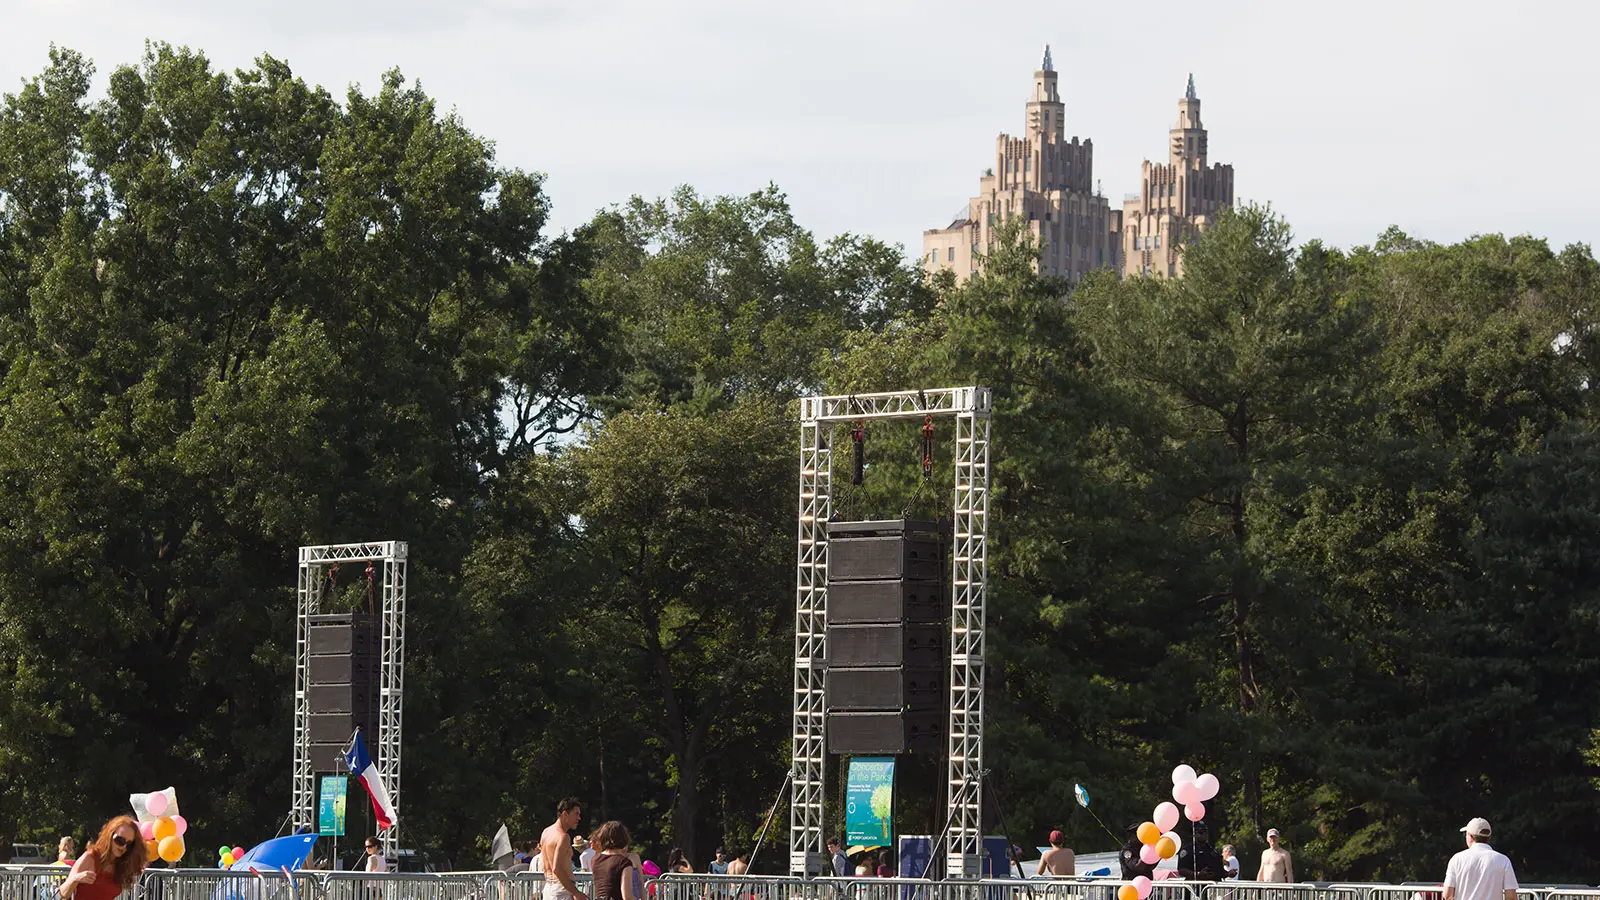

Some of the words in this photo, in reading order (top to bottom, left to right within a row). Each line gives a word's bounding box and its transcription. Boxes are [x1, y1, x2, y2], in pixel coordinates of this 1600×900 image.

[851, 762, 883, 771] Concerts
[849, 772, 856, 781] in
[857, 772, 868, 781] the
[870, 772, 891, 782] Parks
